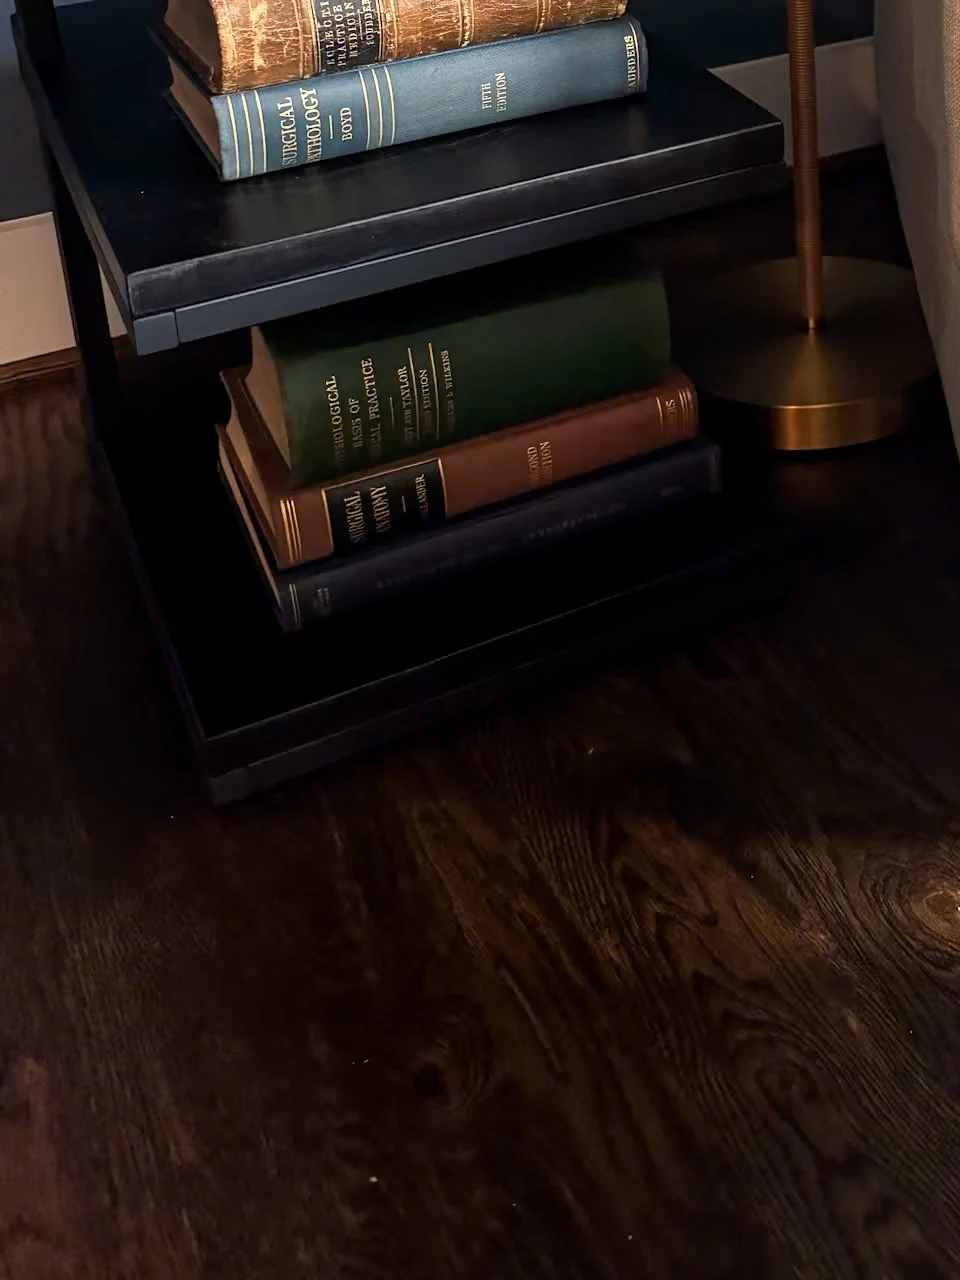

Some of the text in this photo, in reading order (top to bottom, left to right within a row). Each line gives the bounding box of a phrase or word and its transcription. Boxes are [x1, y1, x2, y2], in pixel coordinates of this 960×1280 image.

[332, 4, 347, 67] PRACTICE
[623, 35, 637, 90] AUNDERS
[480, 82, 492, 110] FIFTH
[494, 72, 507, 113] EDITION
[276, 96, 298, 167] SURGICAL
[299, 87, 322, 163] PATHOLOGY
[339, 107, 353, 142] BOYD
[361, 357, 381, 420] PRACTICE
[397, 365, 412, 409] TAYLOR
[419, 369, 432, 409] EDITION
[440, 350, 453, 390] WILKINS
[348, 397, 361, 414] OF
